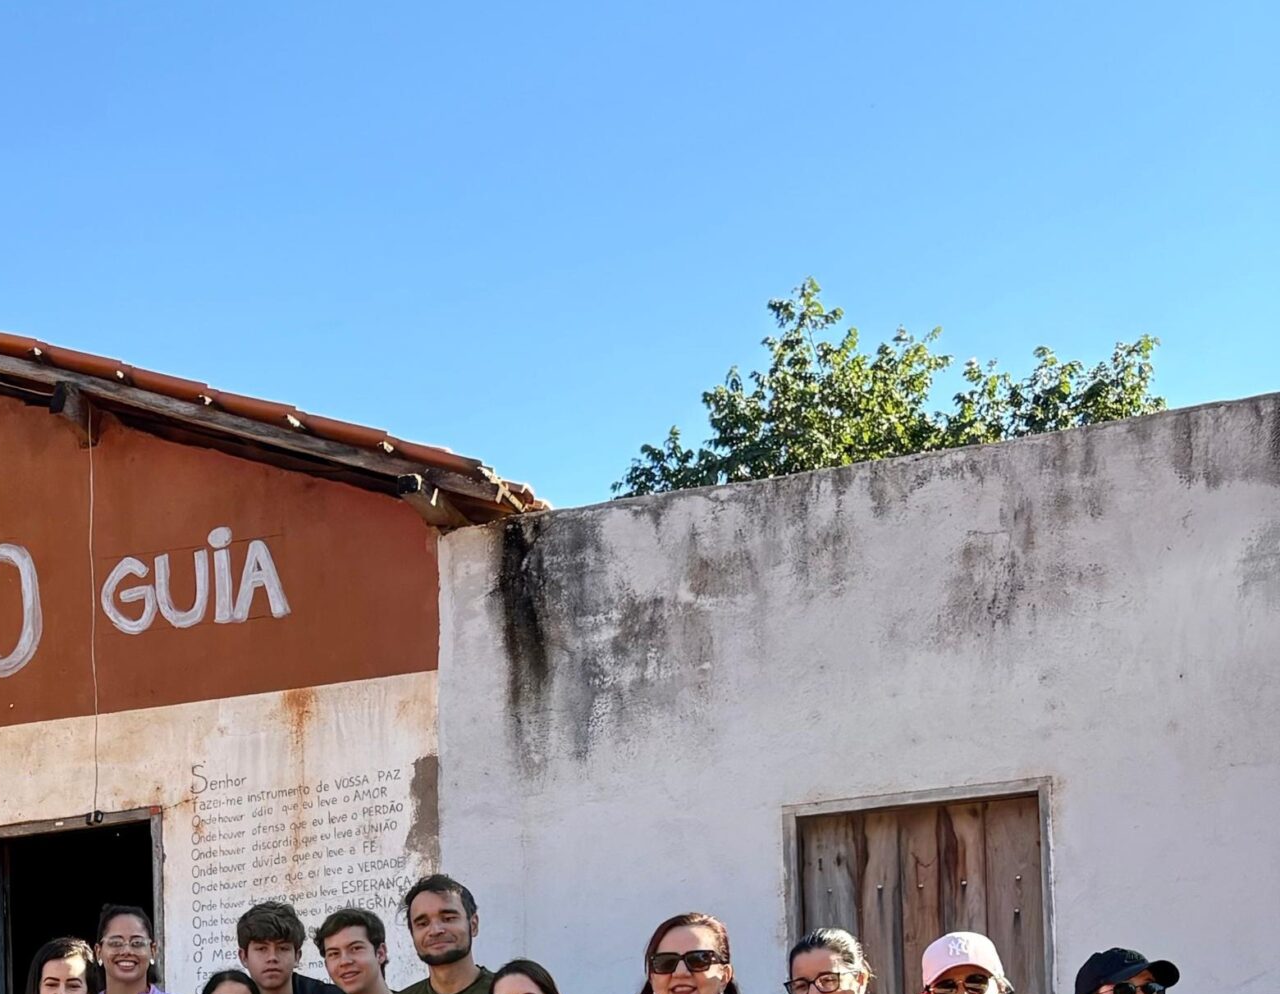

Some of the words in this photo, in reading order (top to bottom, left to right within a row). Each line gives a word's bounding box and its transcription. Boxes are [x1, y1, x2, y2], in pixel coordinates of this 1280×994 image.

[190, 764, 247, 794] Senhor
[247, 784, 310, 803] instrumento
[316, 780, 329, 793] de
[334, 774, 369, 790] VOSSA
[377, 769, 401, 782] PAZ
[191, 814, 217, 828] Onde
[219, 814, 245, 824] houver
[282, 802, 299, 814] que
[302, 800, 313, 809] eu
[317, 795, 337, 808] leve
[343, 795, 350, 803] o
[353, 786, 388, 802] AMOR
[191, 831, 217, 845] Onde
[219, 830, 246, 841] houver
[251, 822, 286, 836] ofensa
[289, 821, 307, 833] que
[312, 818, 323, 827] eu
[328, 811, 348, 824] leve
[351, 812, 358, 820] o
[362, 800, 404, 817] PERDÃO
[191, 847, 218, 861] Onde
[219, 846, 246, 857] houver
[301, 834, 318, 848] que
[320, 832, 331, 841] eu
[334, 827, 353, 840] leve
[363, 818, 398, 834] UNIÃO
[191, 863, 218, 878] Onde
[219, 862, 246, 873] houver
[252, 852, 287, 868] dúvida
[292, 851, 311, 864] que
[312, 850, 323, 859] eu
[326, 847, 344, 858] leve
[349, 846, 356, 855] a
[362, 836, 377, 853] FÉ
[192, 881, 218, 895] Onde
[219, 879, 247, 891] houver
[252, 875, 278, 887] erro
[285, 871, 303, 885] que
[308, 869, 320, 879] eu
[324, 865, 343, 876] leve
[347, 865, 354, 874] a
[357, 856, 405, 873] VERDADE
[192, 899, 218, 913] Onde
[220, 898, 246, 910] houver
[289, 891, 305, 904] que
[306, 889, 318, 898] eu
[320, 885, 338, 897] leve
[192, 914, 219, 929] Onde
[310, 907, 321, 916] eu
[345, 896, 397, 910] ALEGRIA
[192, 931, 219, 947] Onde
[212, 948, 238, 962] Mes
